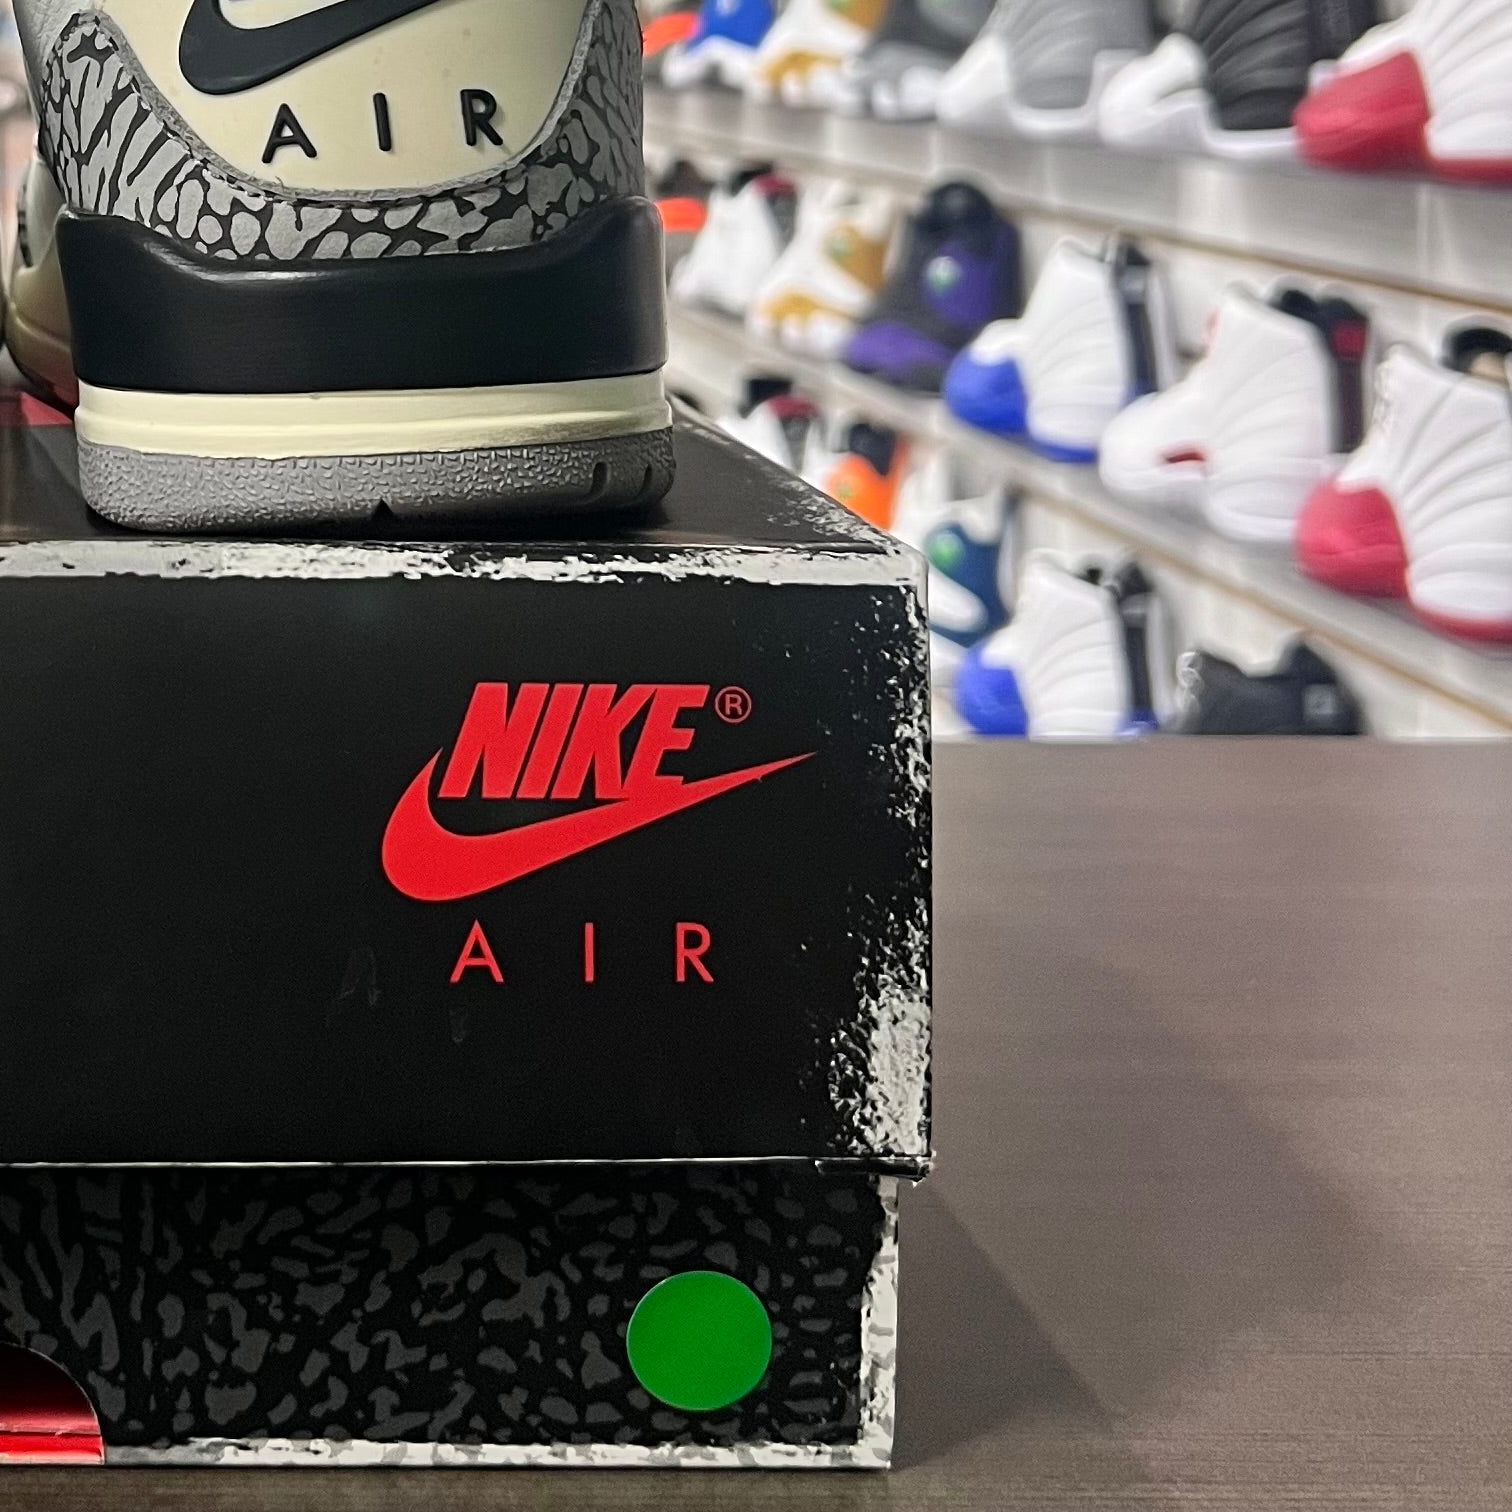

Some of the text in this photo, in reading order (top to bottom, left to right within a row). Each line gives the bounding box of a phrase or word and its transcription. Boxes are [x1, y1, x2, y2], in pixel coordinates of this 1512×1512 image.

[262, 88, 504, 164] AIR
[438, 682, 711, 799] NIKE
[450, 919, 715, 983] AIR
